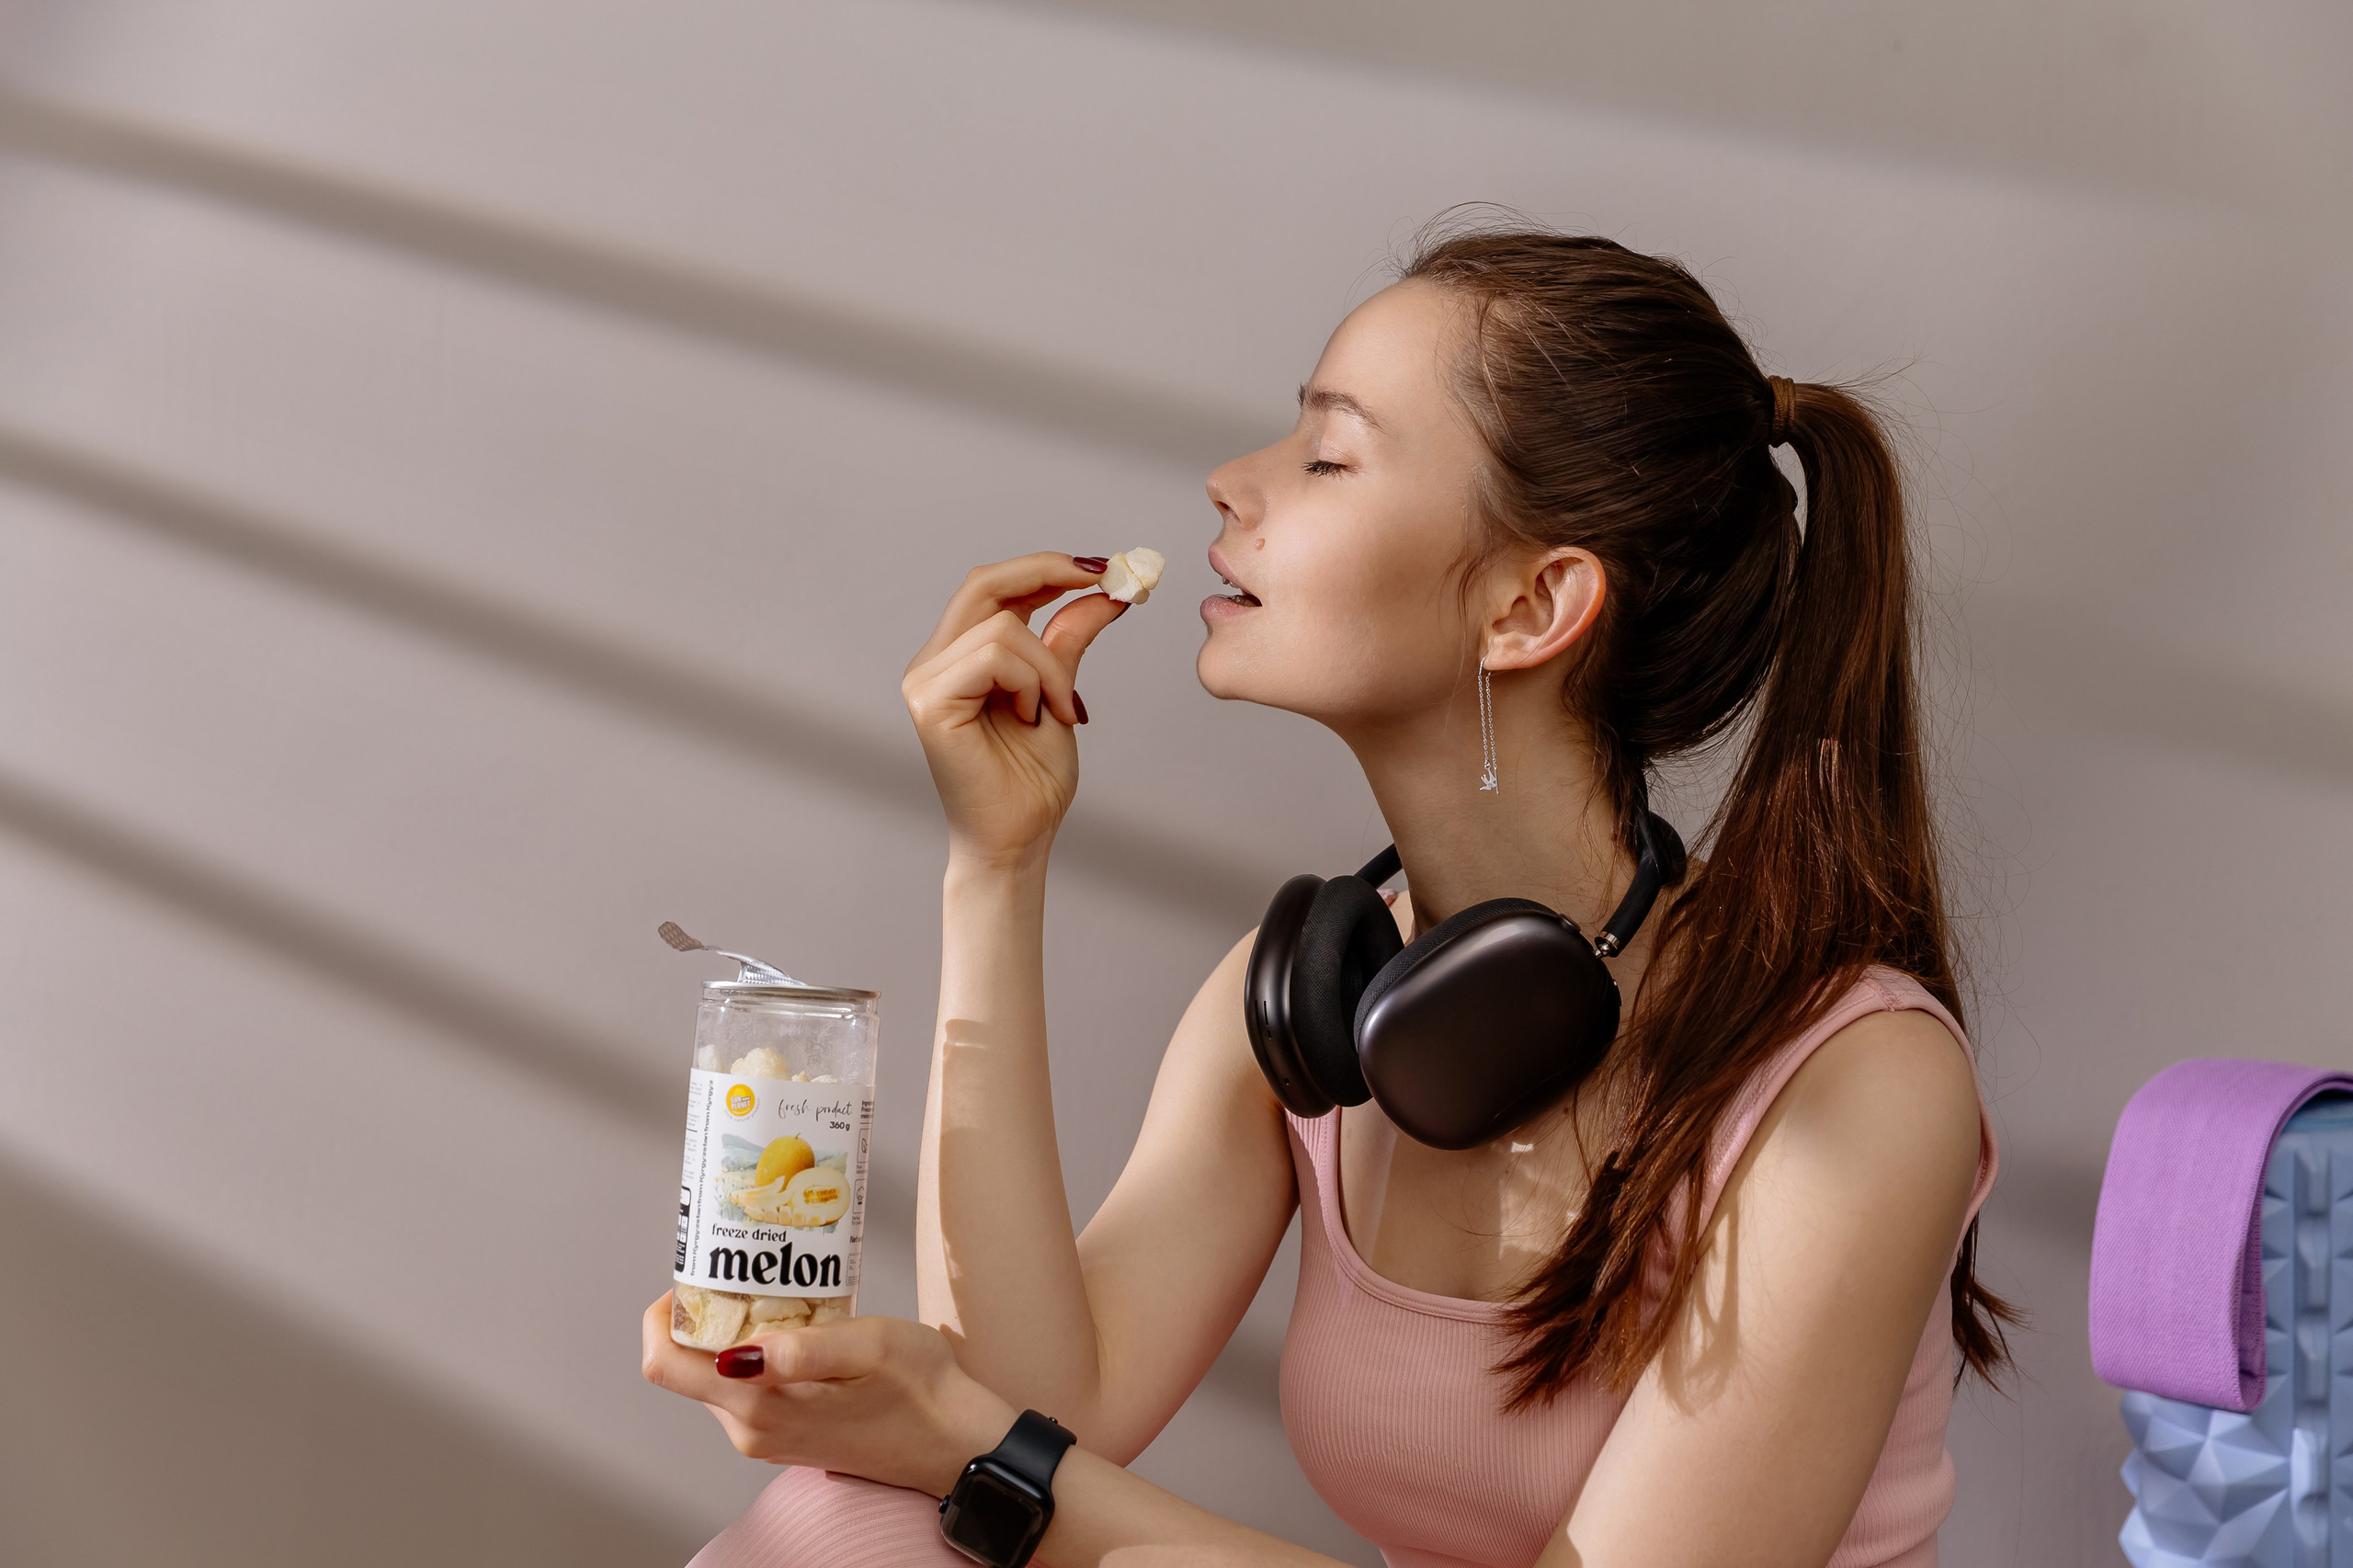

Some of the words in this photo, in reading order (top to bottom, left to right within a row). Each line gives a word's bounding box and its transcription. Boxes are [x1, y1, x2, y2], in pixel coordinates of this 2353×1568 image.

[779, 1099, 811, 1119] fresh
[815, 1100, 851, 1121] product
[829, 1121, 845, 1130] 360
[845, 1123, 850, 1131] g
[692, 1204, 702, 1255] Kyrgyzstan
[699, 1131, 709, 1183] Kyrgyzstan
[711, 1223, 748, 1239] freeze
[752, 1228, 787, 1242] dried
[709, 1241, 841, 1287] melon
